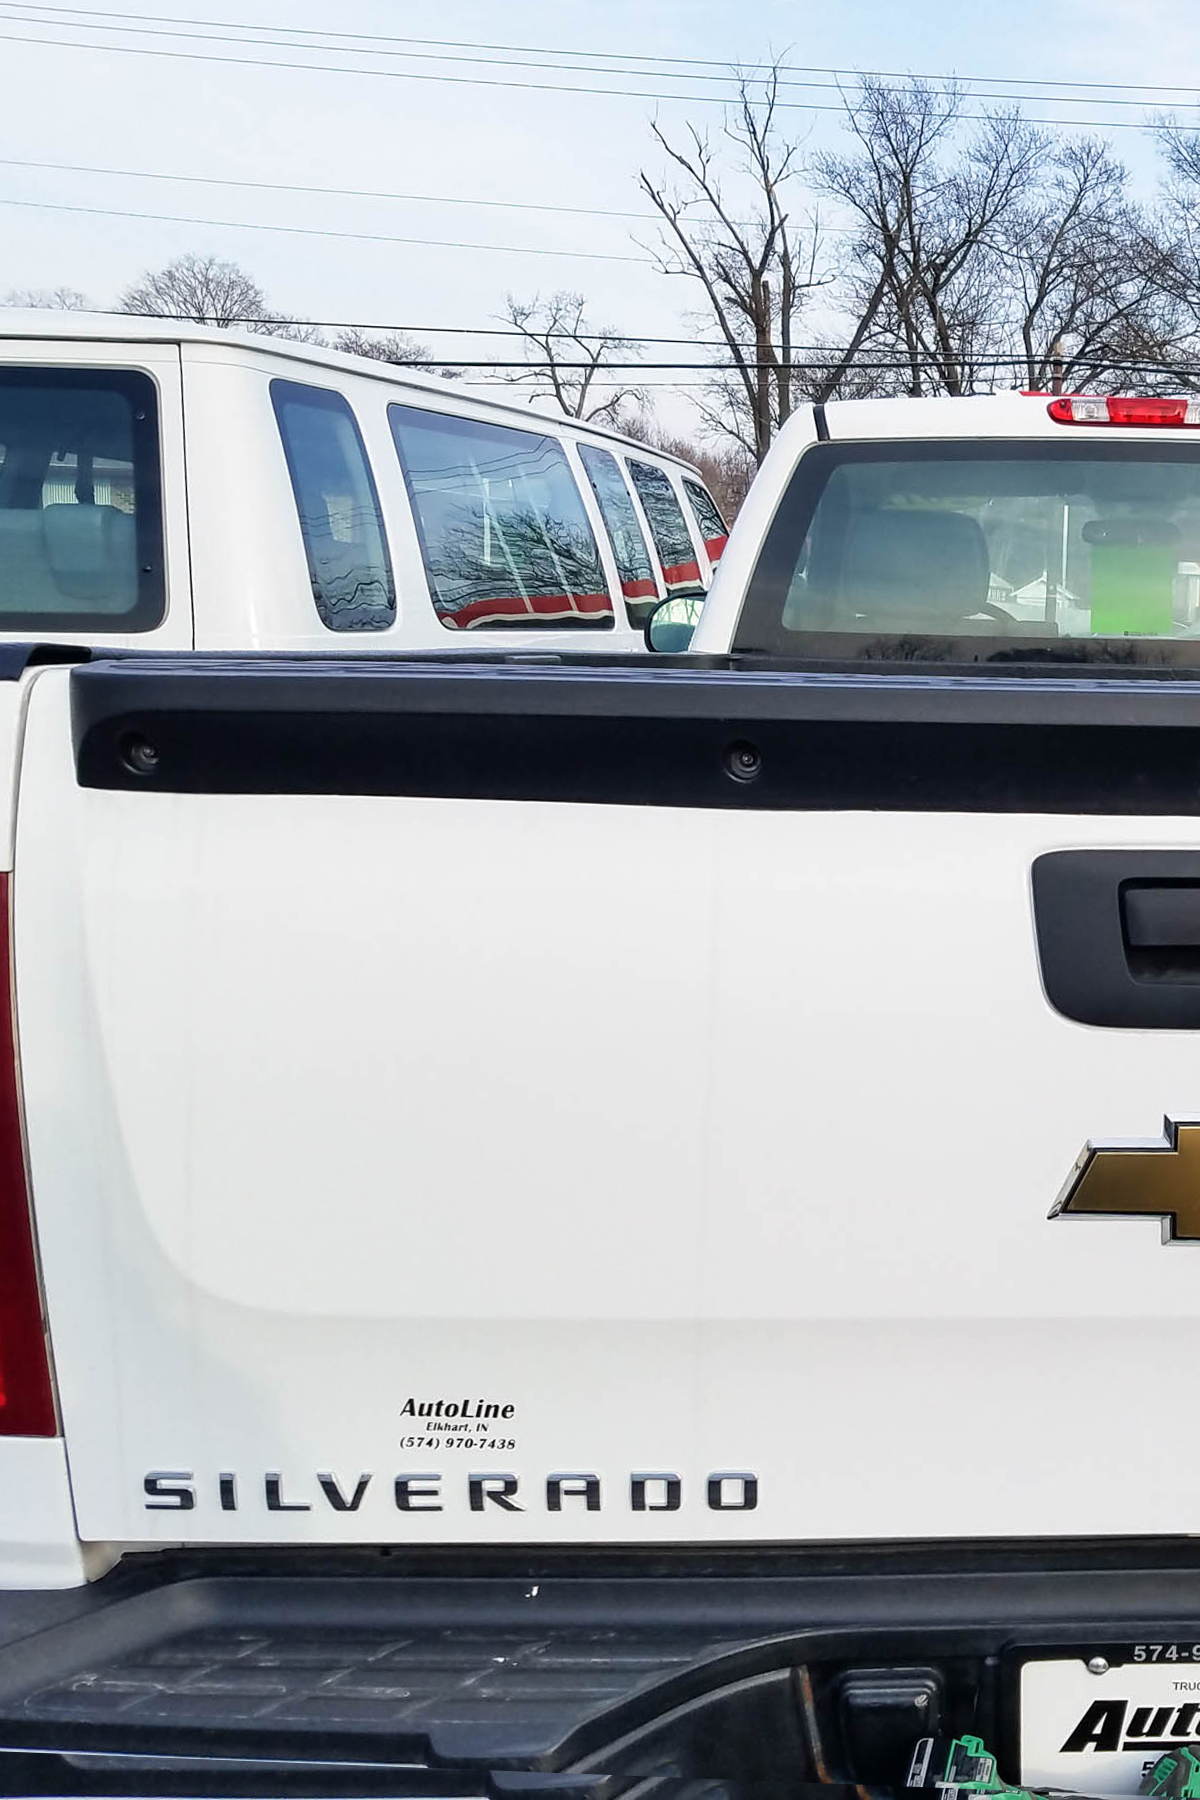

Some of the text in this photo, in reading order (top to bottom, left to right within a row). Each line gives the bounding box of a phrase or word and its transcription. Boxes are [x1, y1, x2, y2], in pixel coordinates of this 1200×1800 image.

[399, 1397, 516, 1420] AutoLine
[425, 1422, 489, 1433] Elkhart, IN
[399, 1437, 516, 1450] (574) 970-7438
[143, 1470, 760, 1512] SILVERADO
